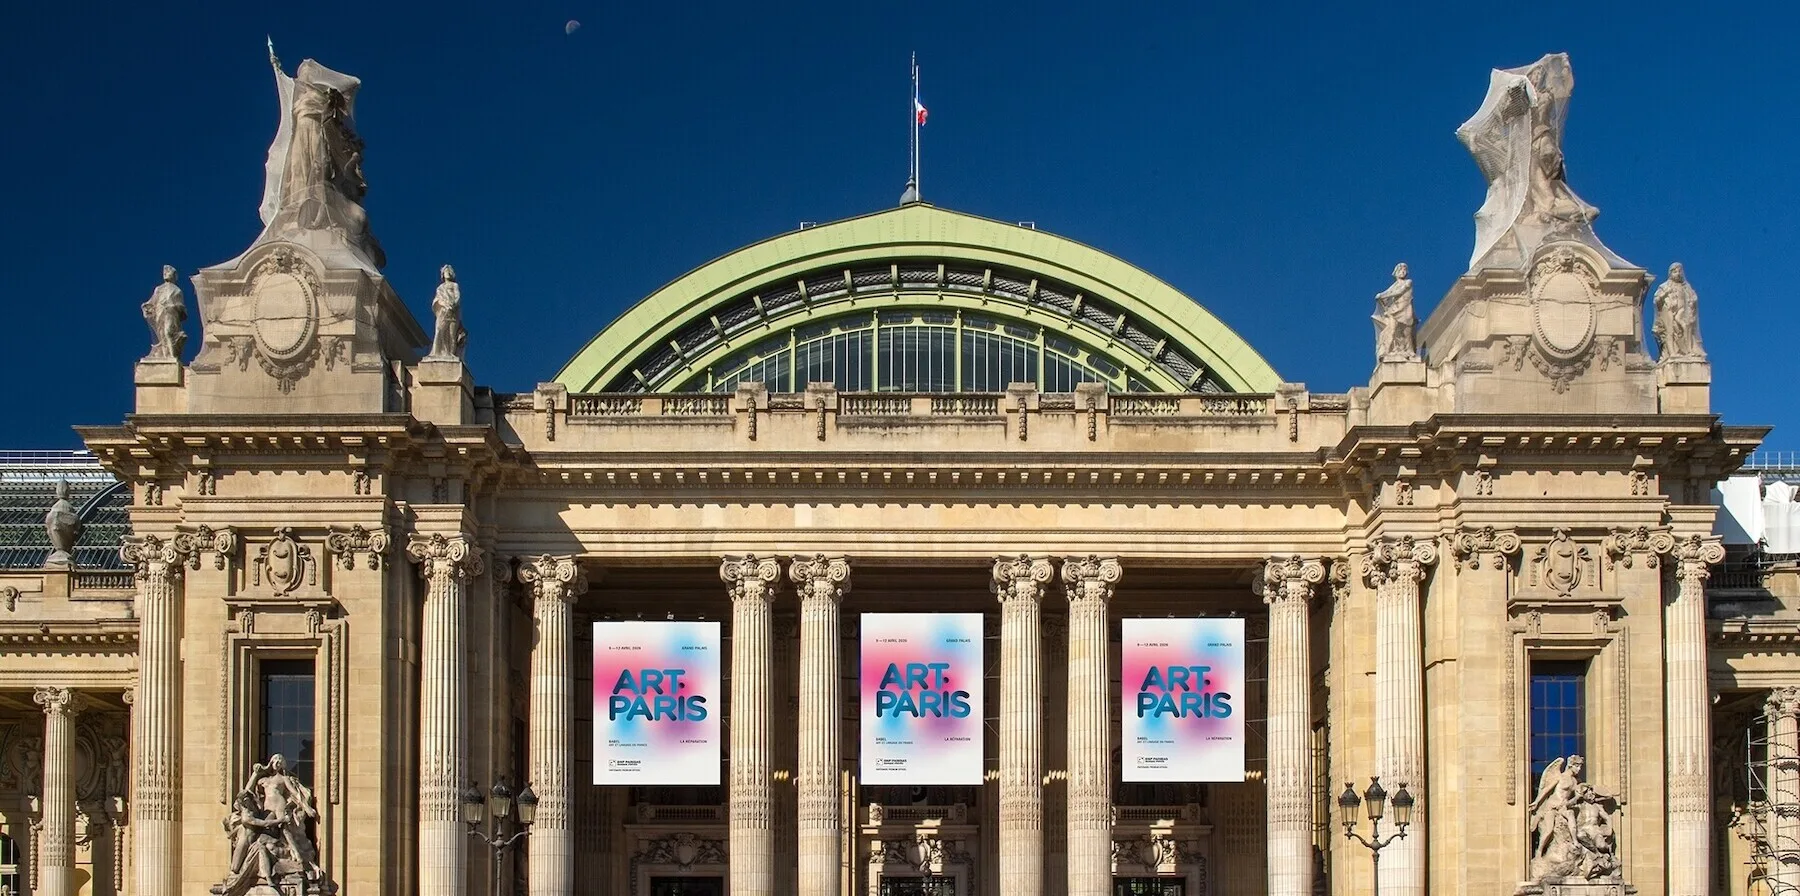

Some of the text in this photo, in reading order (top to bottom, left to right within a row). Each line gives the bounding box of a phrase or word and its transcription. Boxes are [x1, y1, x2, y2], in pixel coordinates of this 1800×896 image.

[609, 696, 707, 722] PARIS
[876, 690, 971, 718] PARIS
[1137, 692, 1232, 718] PARIS
